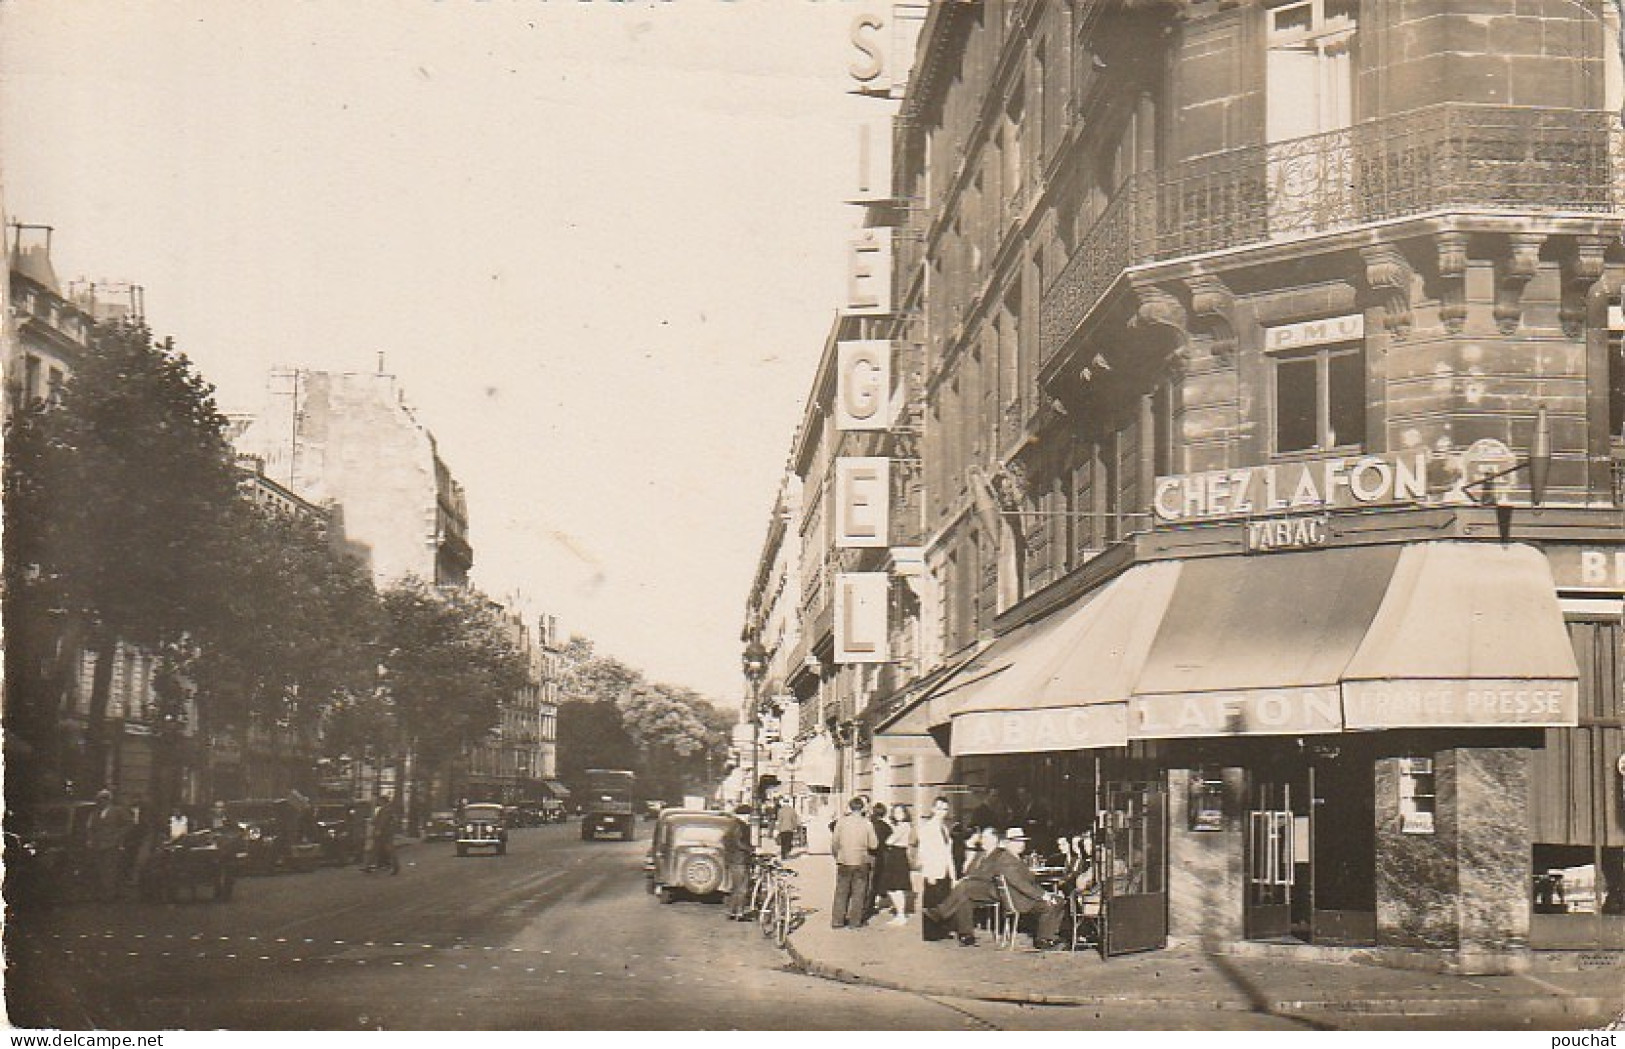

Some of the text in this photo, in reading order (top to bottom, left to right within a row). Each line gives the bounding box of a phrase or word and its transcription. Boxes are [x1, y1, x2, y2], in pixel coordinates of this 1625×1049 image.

[1154, 454, 1428, 521] CHEZ LAFON
[1249, 518, 1326, 550] TABAC
[1138, 691, 1340, 731] LAFON
[1467, 690, 1562, 714] PRESSE
